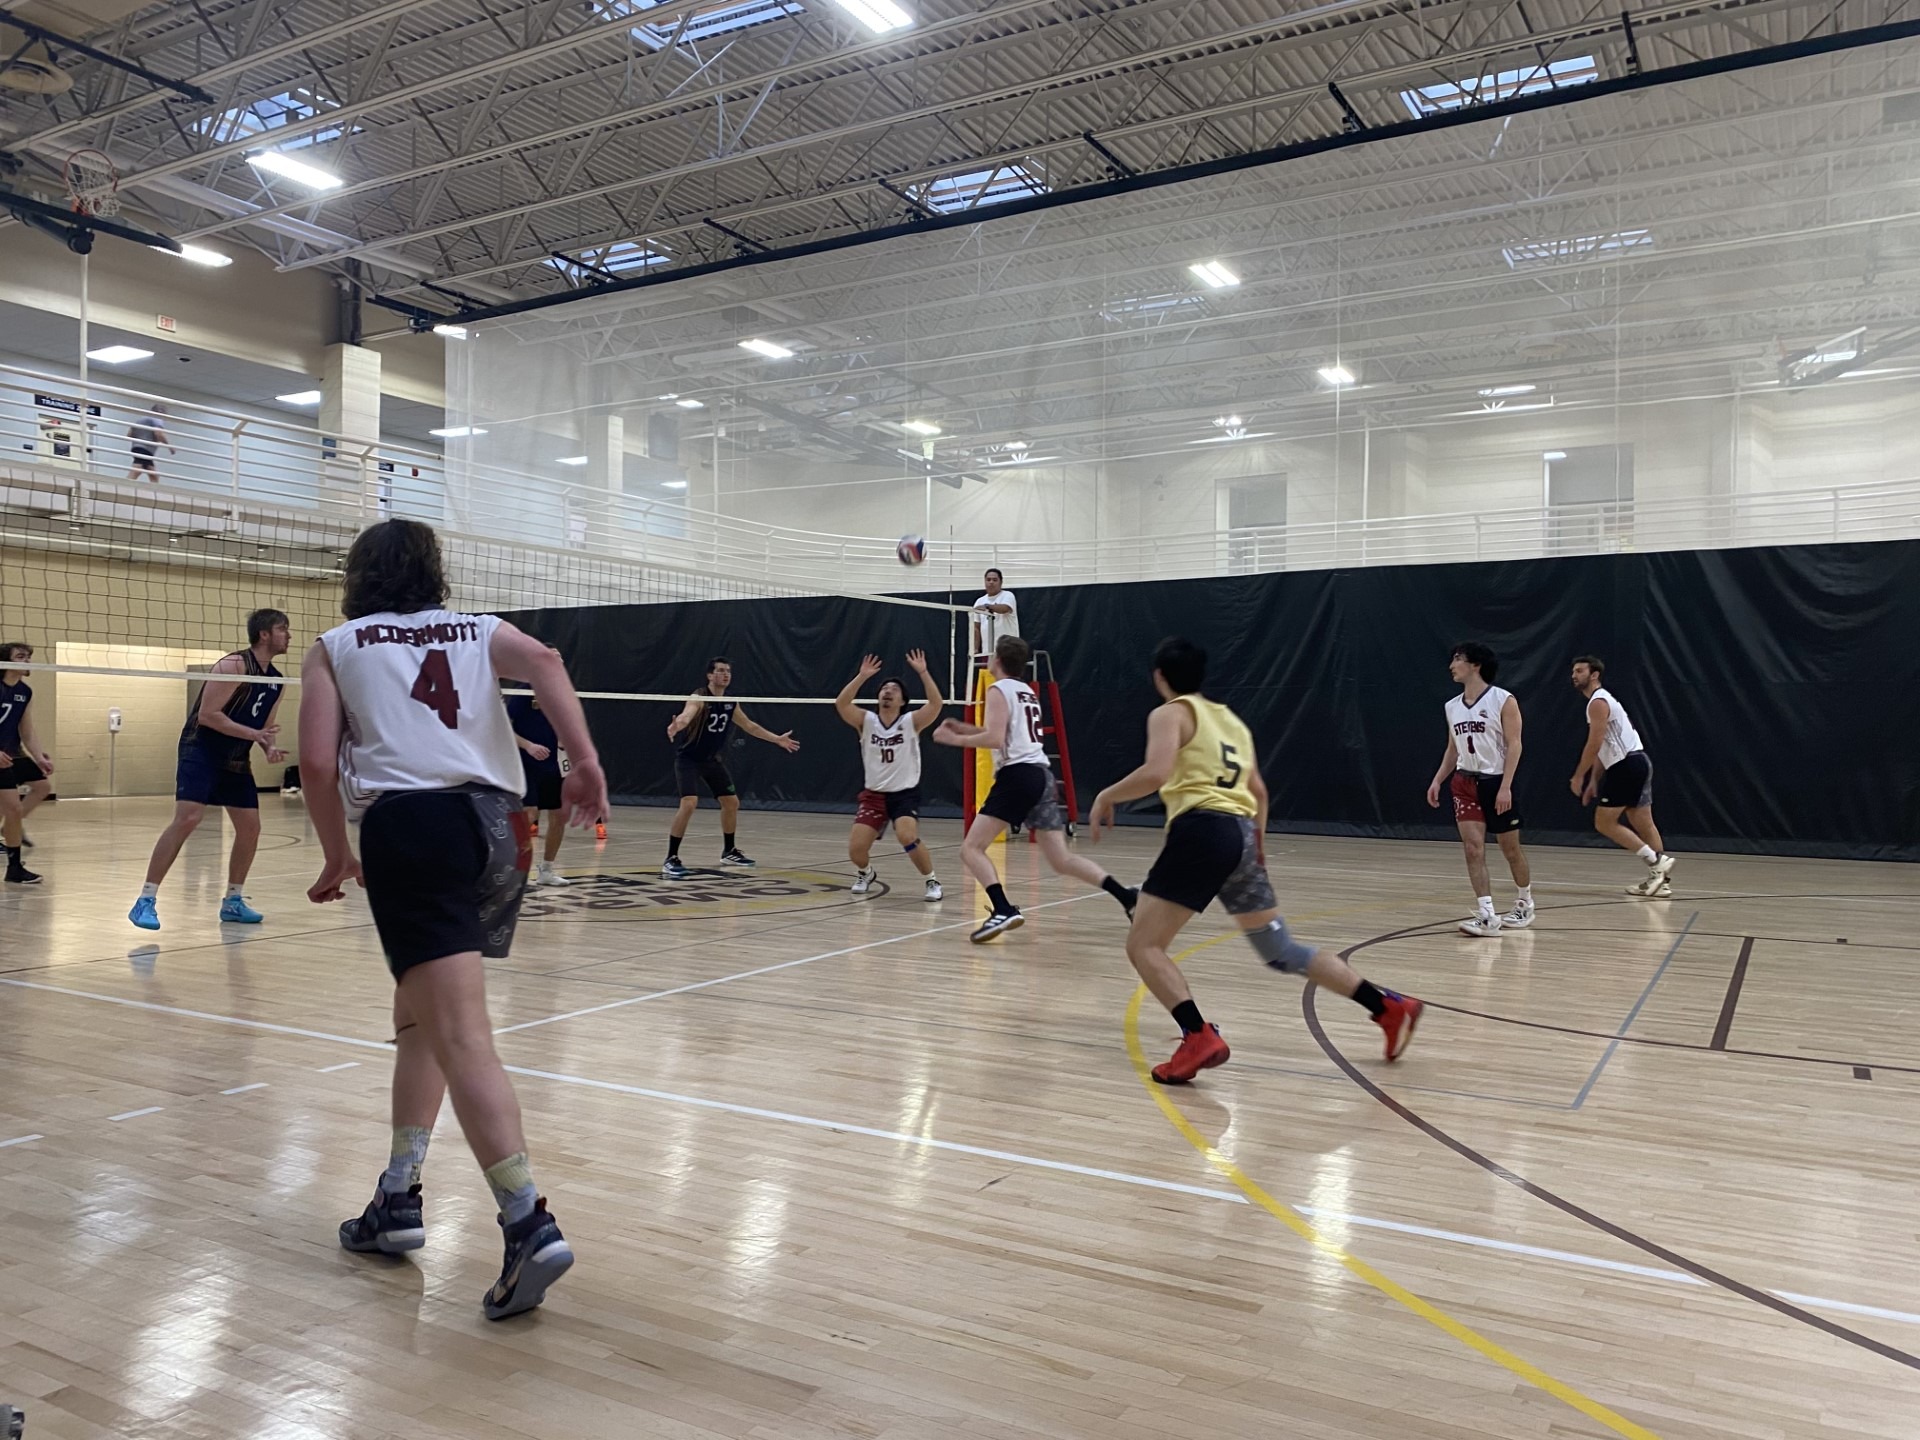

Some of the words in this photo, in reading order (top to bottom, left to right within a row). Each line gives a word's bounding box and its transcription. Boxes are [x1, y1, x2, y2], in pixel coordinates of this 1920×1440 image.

[160, 316, 174, 329] EXIT
[355, 622, 477, 648] MCDERMOTT
[410, 649, 461, 729] 4
[1, 703, 12, 724] 7
[708, 714, 728, 732] 23
[1025, 706, 1043, 743] 12
[881, 748, 894, 763] 10
[1217, 741, 1241, 789] 5
